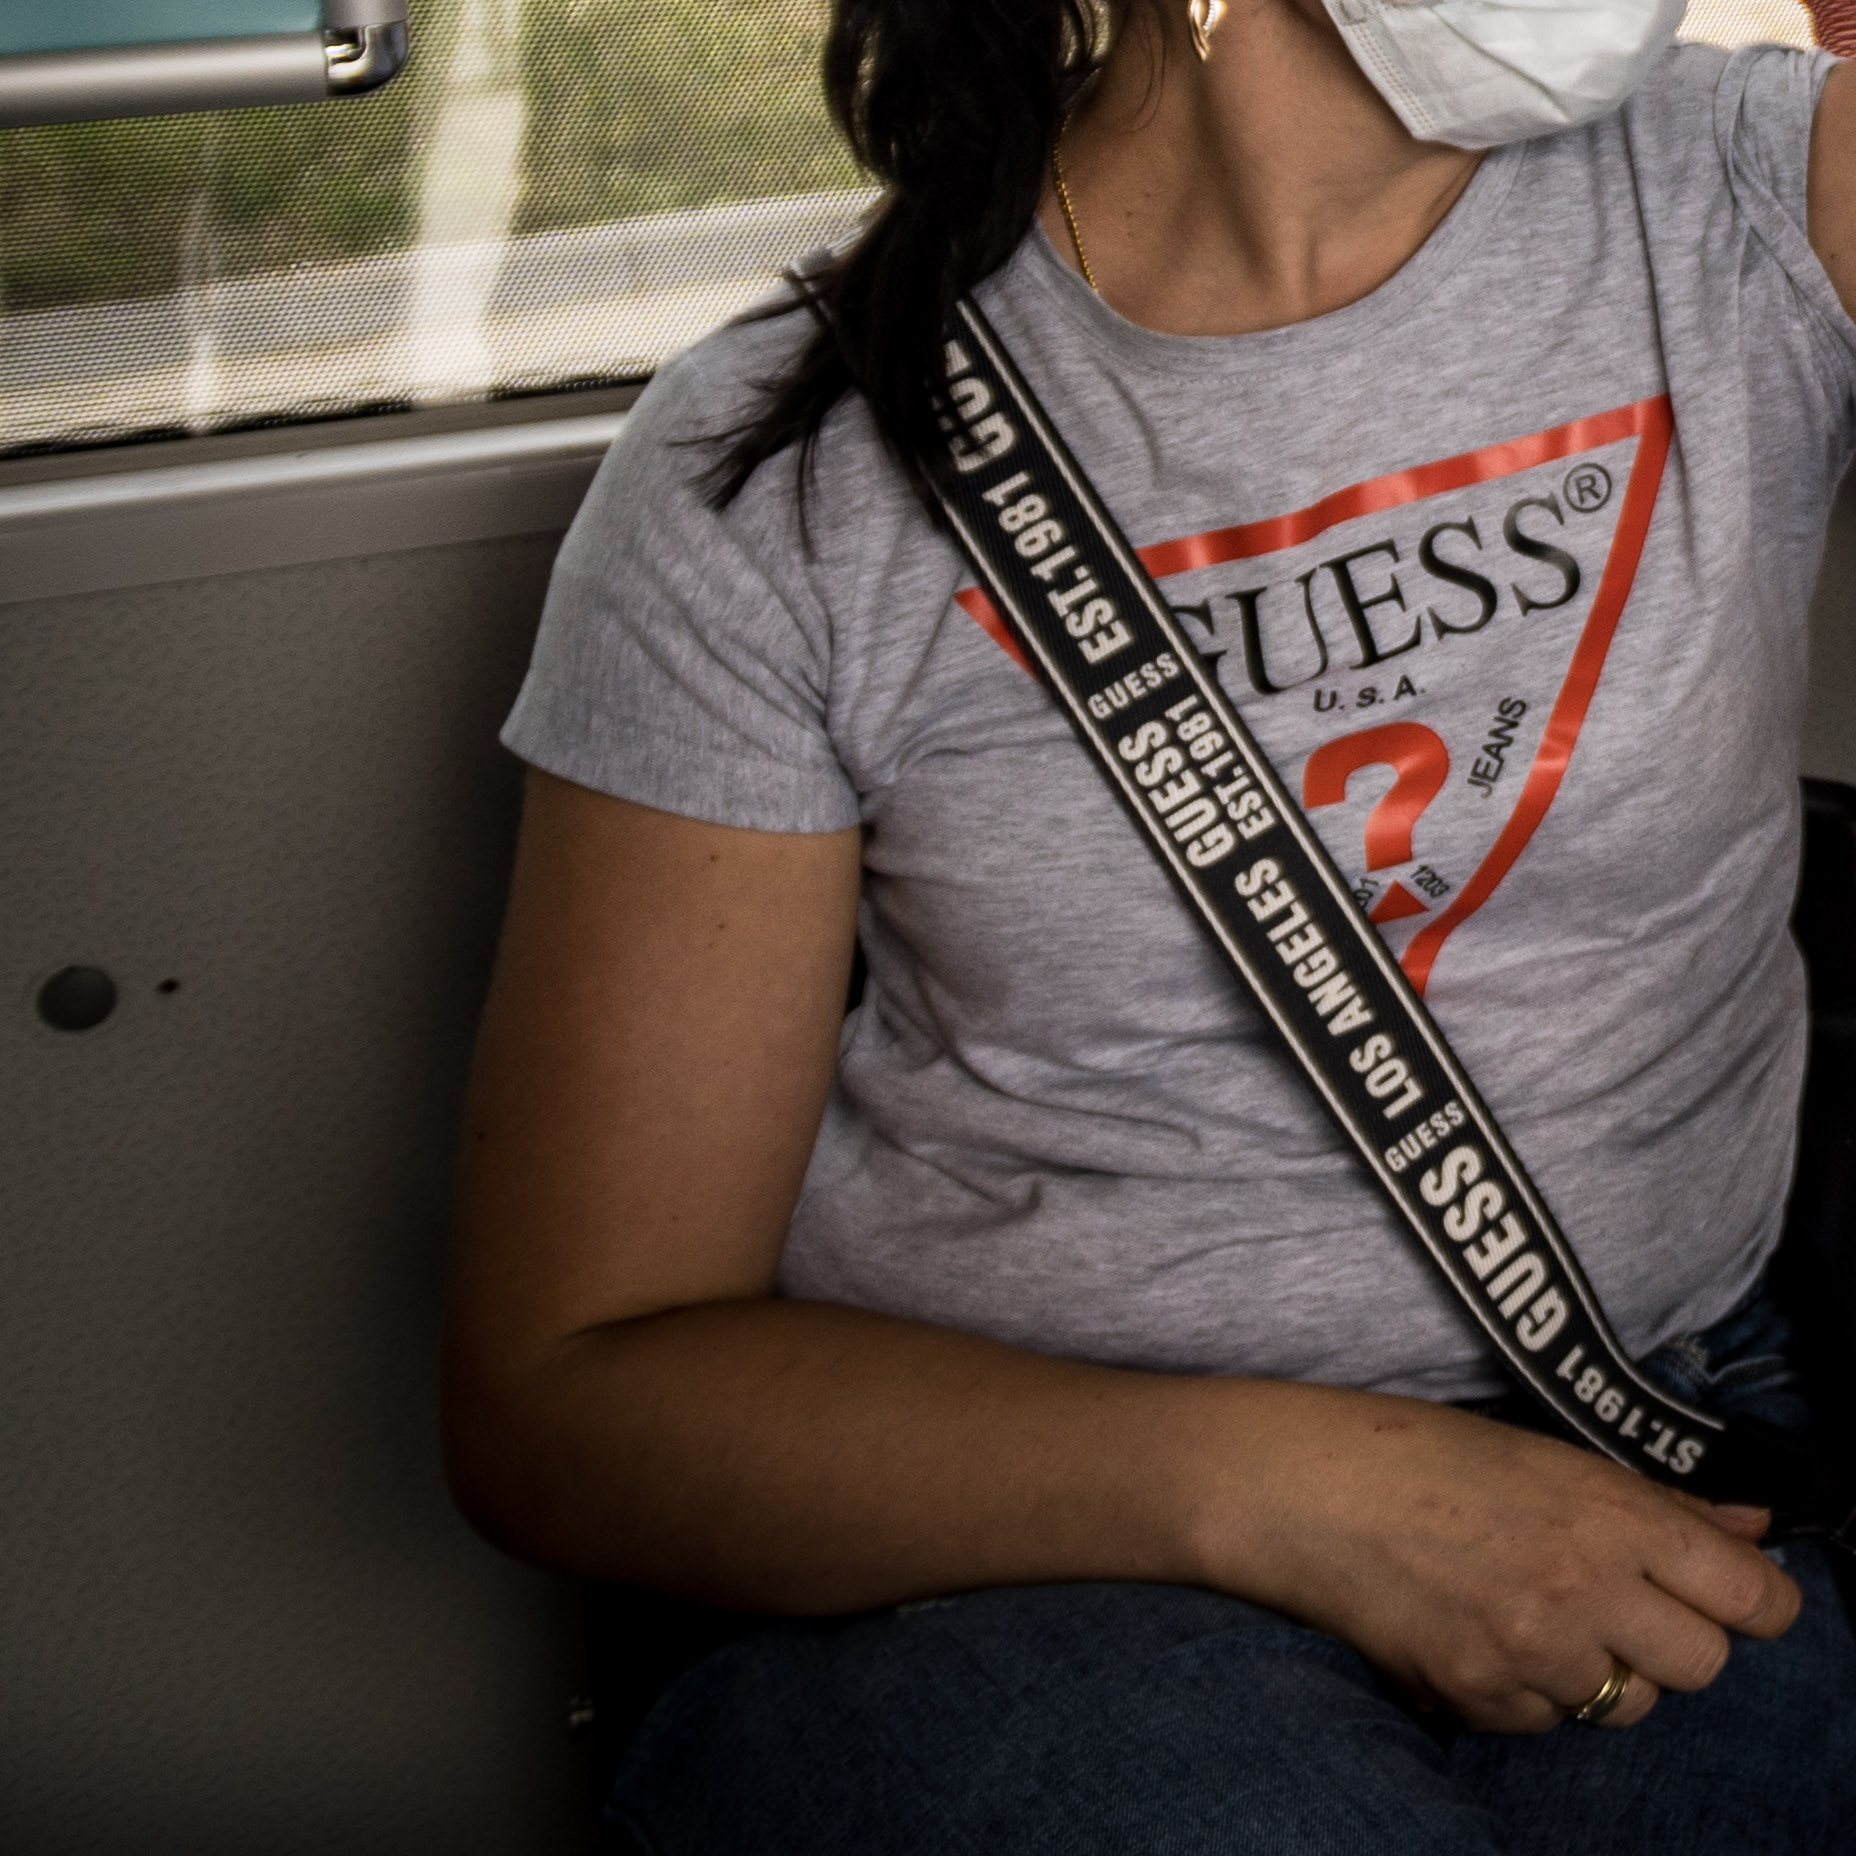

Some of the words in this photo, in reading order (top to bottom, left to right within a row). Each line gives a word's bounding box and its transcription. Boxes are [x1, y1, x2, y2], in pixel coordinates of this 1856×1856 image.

[981, 469, 1133, 665] EST.1981
[1086, 651, 1179, 720] GUESS
[1465, 695, 1529, 800] JEANS
[1117, 719, 1236, 868] GUESS
[1163, 693, 1276, 841] EST.1981
[1233, 857, 1374, 1037] ANGELES
[1409, 864, 1451, 900] 1203
[1348, 1033, 1424, 1121] LOS
[1383, 1099, 1466, 1174] GUESS
[1418, 1144, 1571, 1354] GUESS
[1554, 1345, 1704, 1476] ST.1981
